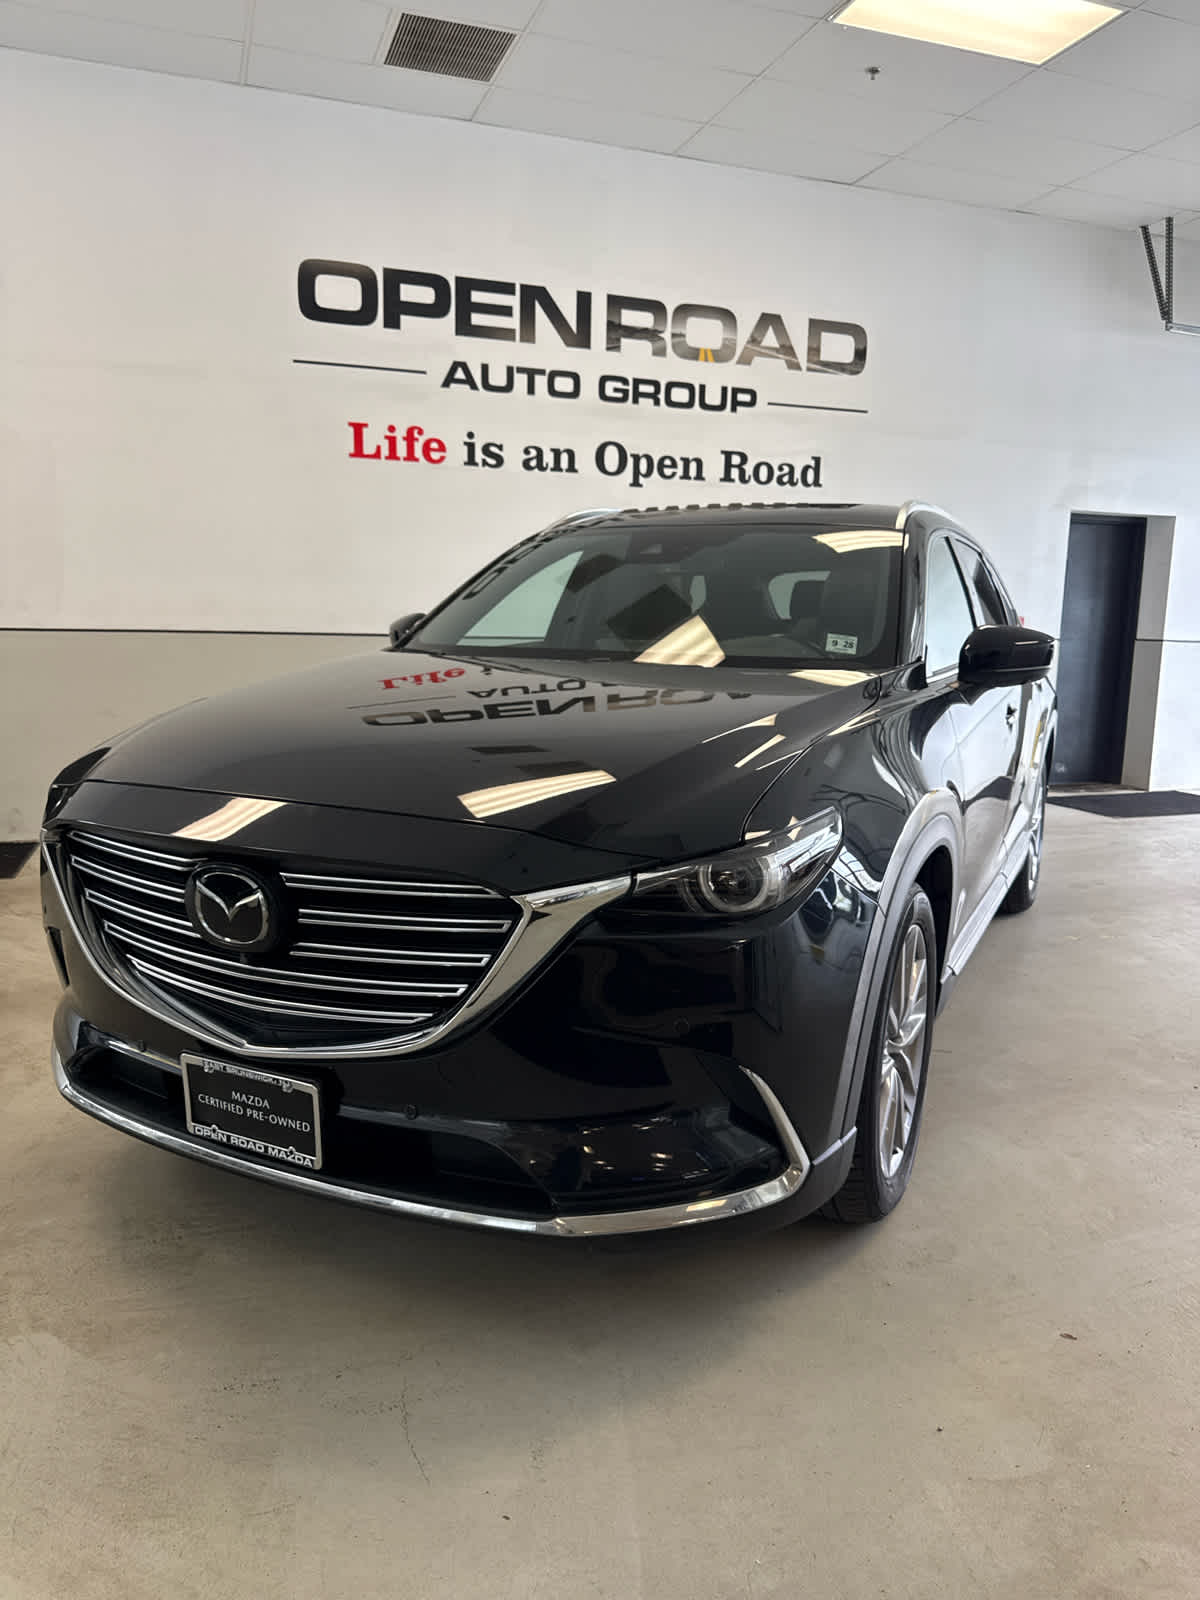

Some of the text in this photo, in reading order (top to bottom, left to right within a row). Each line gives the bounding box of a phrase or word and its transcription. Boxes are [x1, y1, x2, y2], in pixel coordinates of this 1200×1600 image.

[297, 258, 869, 377] OPEN ROAD
[440, 361, 758, 413] AUTO GROUP
[348, 421, 823, 488] Life is an Open Road
[198, 1093, 311, 1132] CERTIFIED PRE-OWNED
[231, 1090, 270, 1109] MAZDA
[194, 1126, 313, 1168] OPEN ROAD MAZDA
